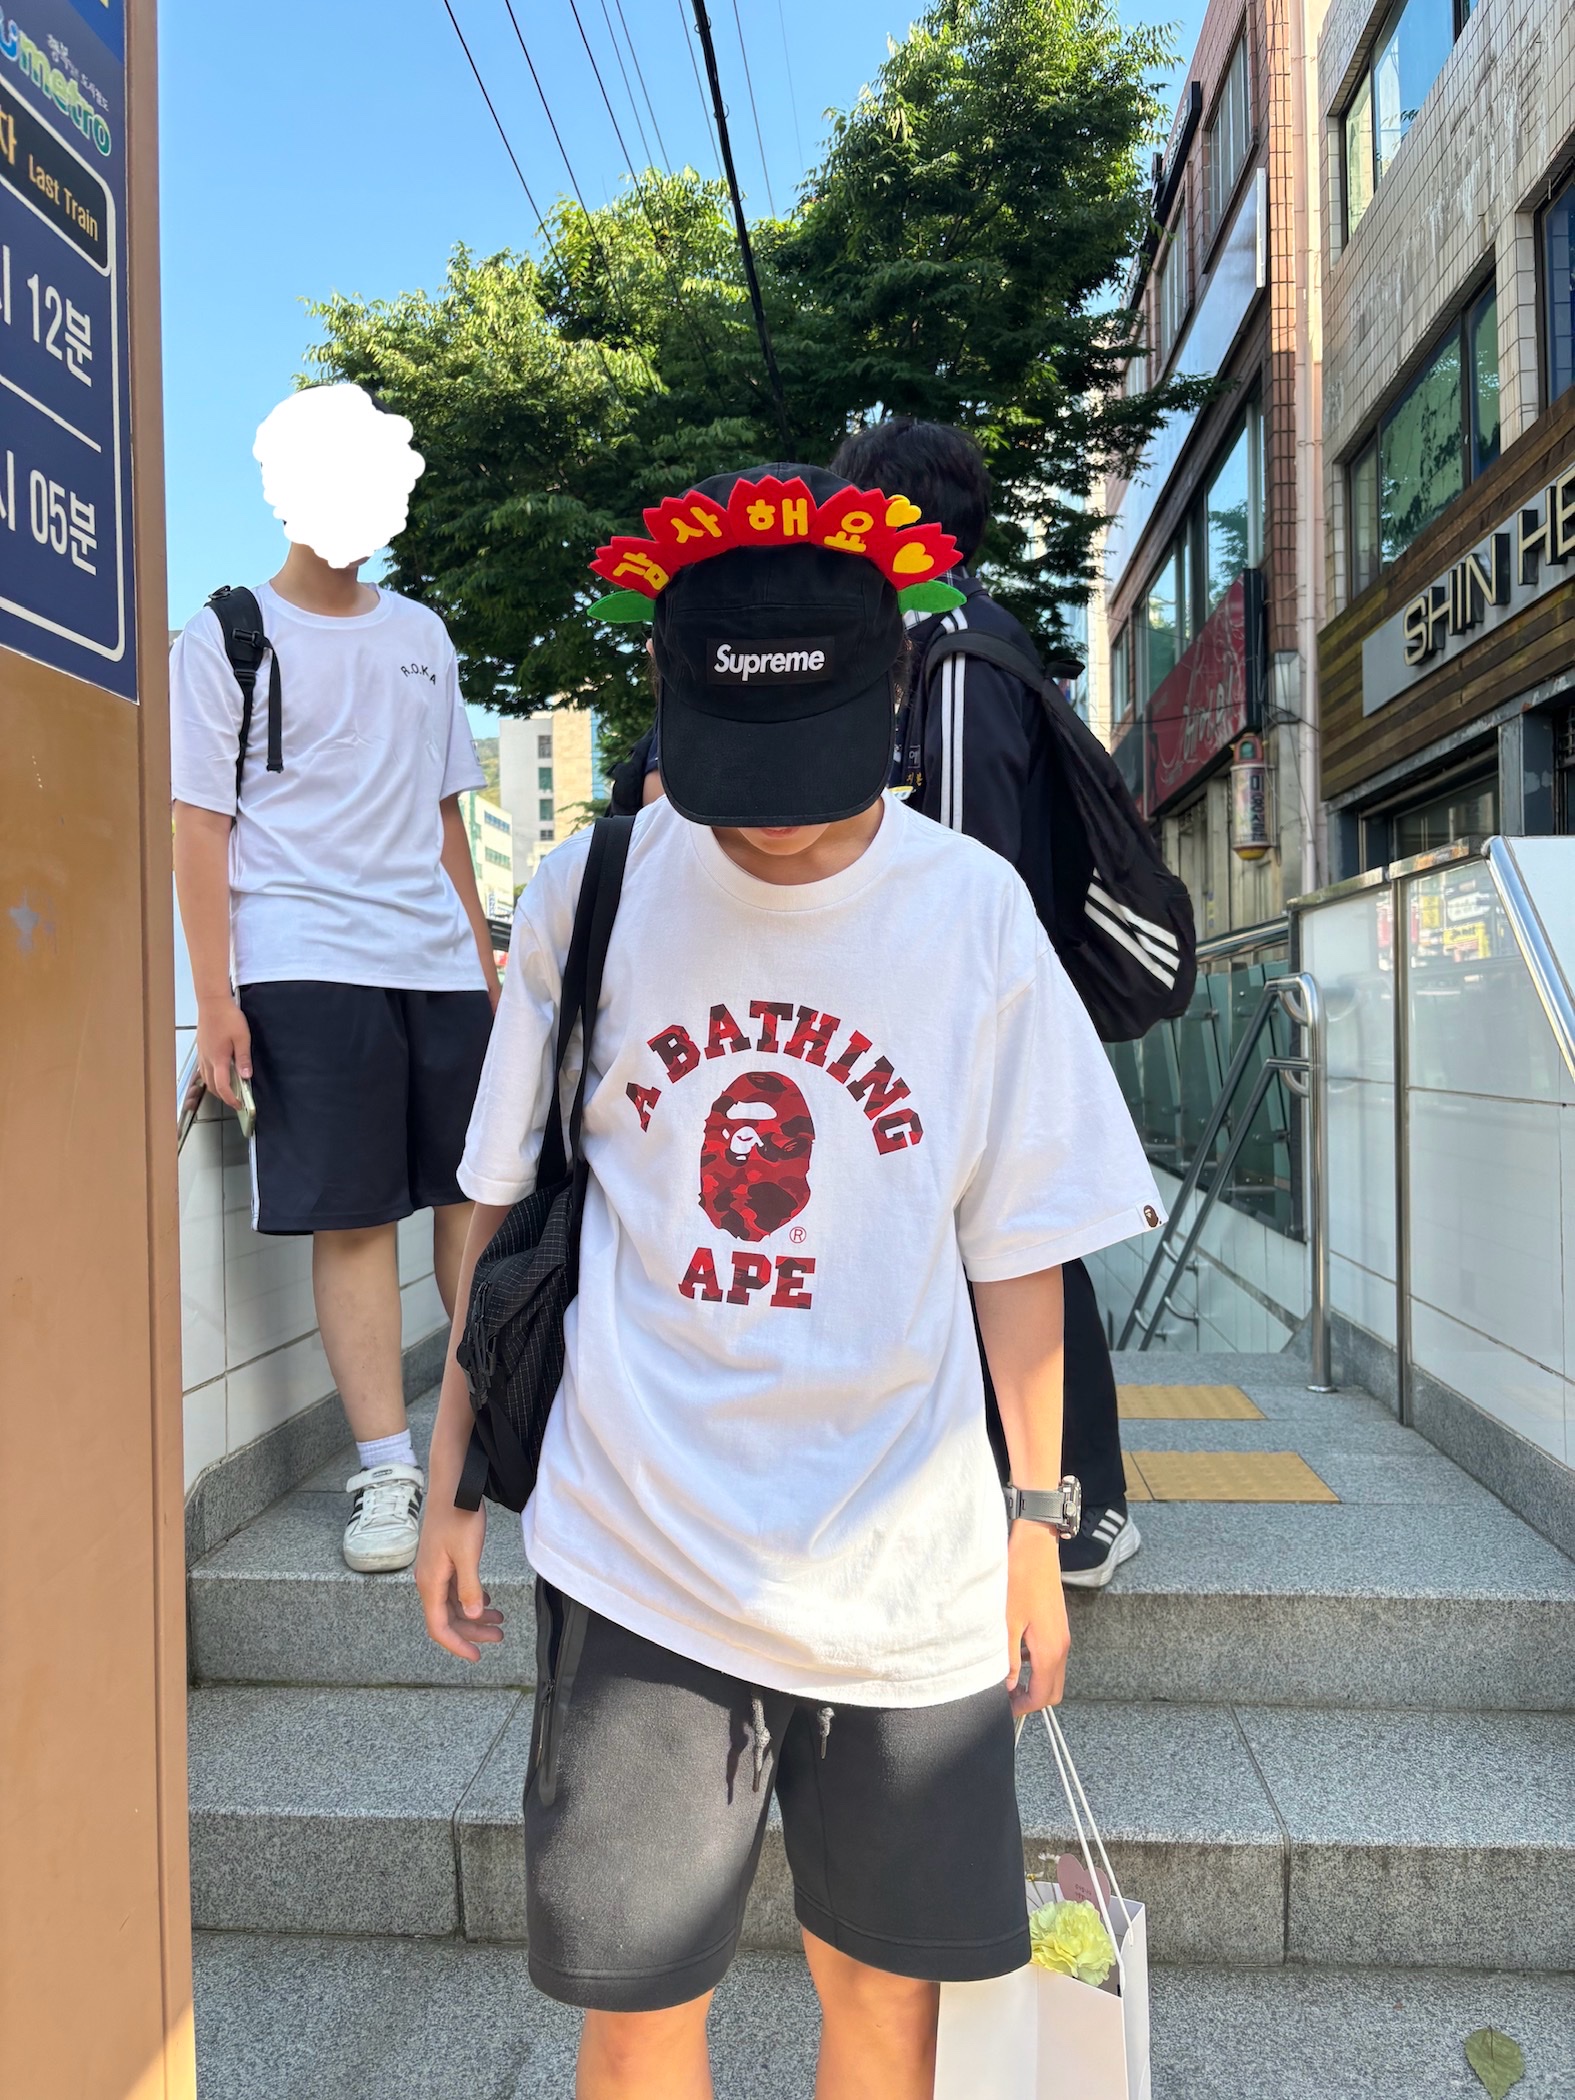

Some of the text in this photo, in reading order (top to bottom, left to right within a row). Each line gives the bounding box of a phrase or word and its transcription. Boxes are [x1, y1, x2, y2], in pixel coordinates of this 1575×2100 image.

[29, 153, 98, 241] Last Train
[27, 273, 92, 388] 12분
[30, 469, 97, 576] 05분
[612, 498, 874, 591] 감사해요
[1403, 532, 1510, 667] SHIN
[714, 643, 826, 682] Supreme
[625, 999, 924, 1156] A BATHING
[678, 1246, 816, 1310] APE
